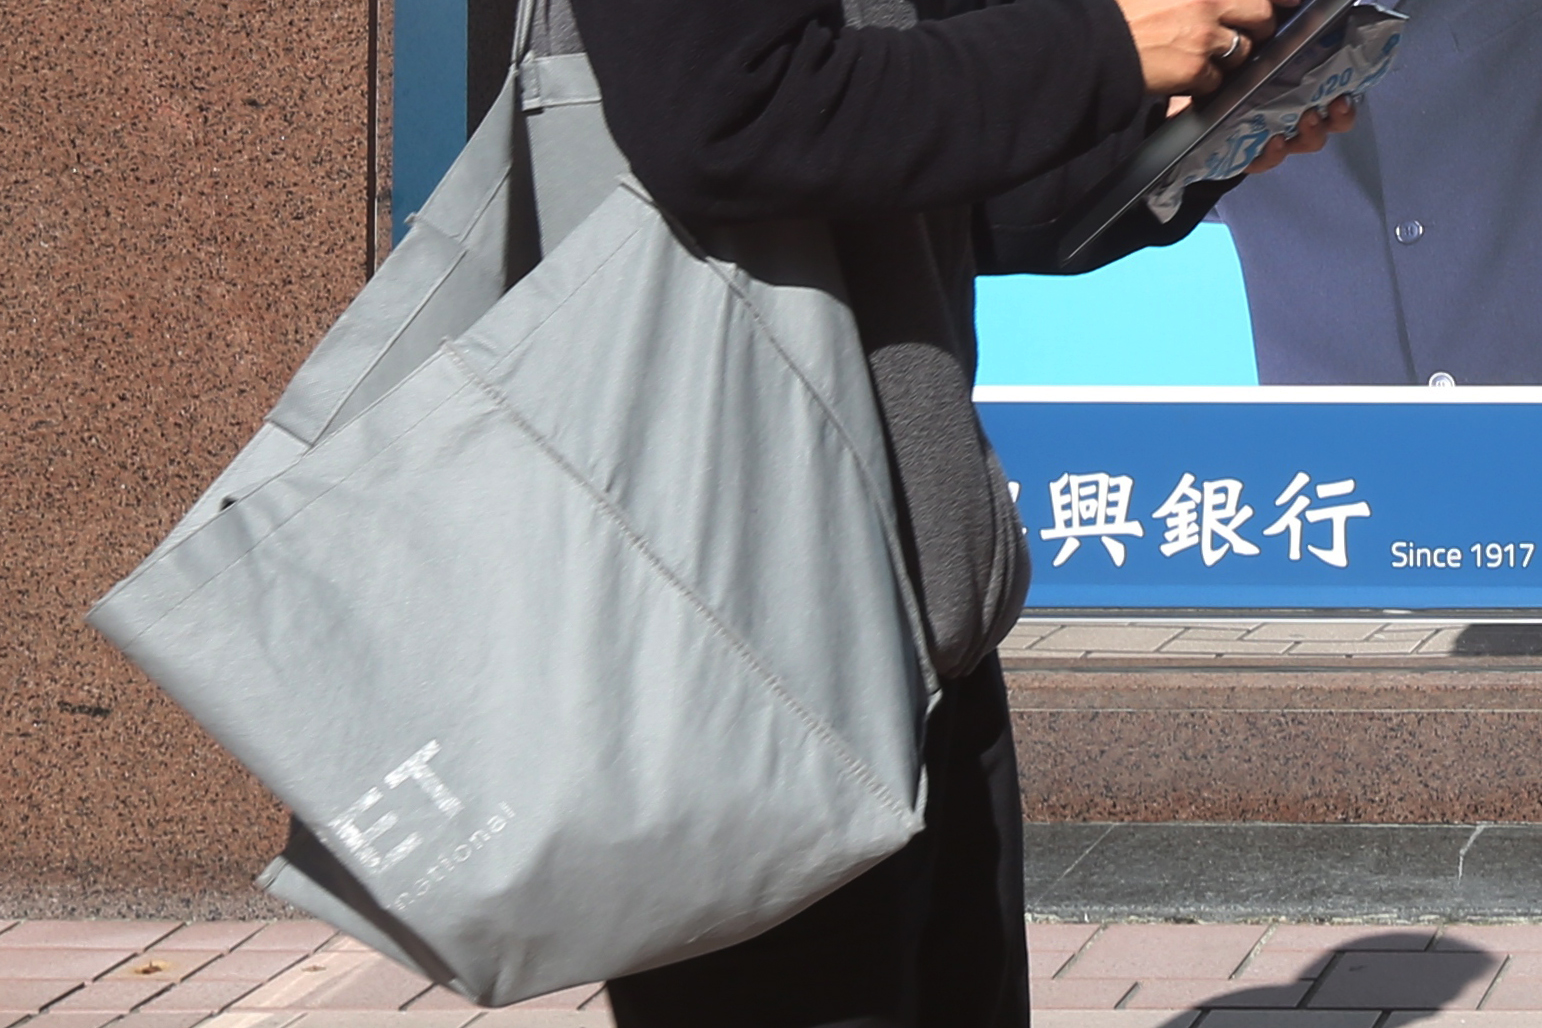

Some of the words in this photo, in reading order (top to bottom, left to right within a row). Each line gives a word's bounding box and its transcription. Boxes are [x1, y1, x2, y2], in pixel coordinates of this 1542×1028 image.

[1008, 472, 1371, 567] 興銀行
[1391, 542, 1462, 568] Since
[1470, 543, 1536, 568] 1917
